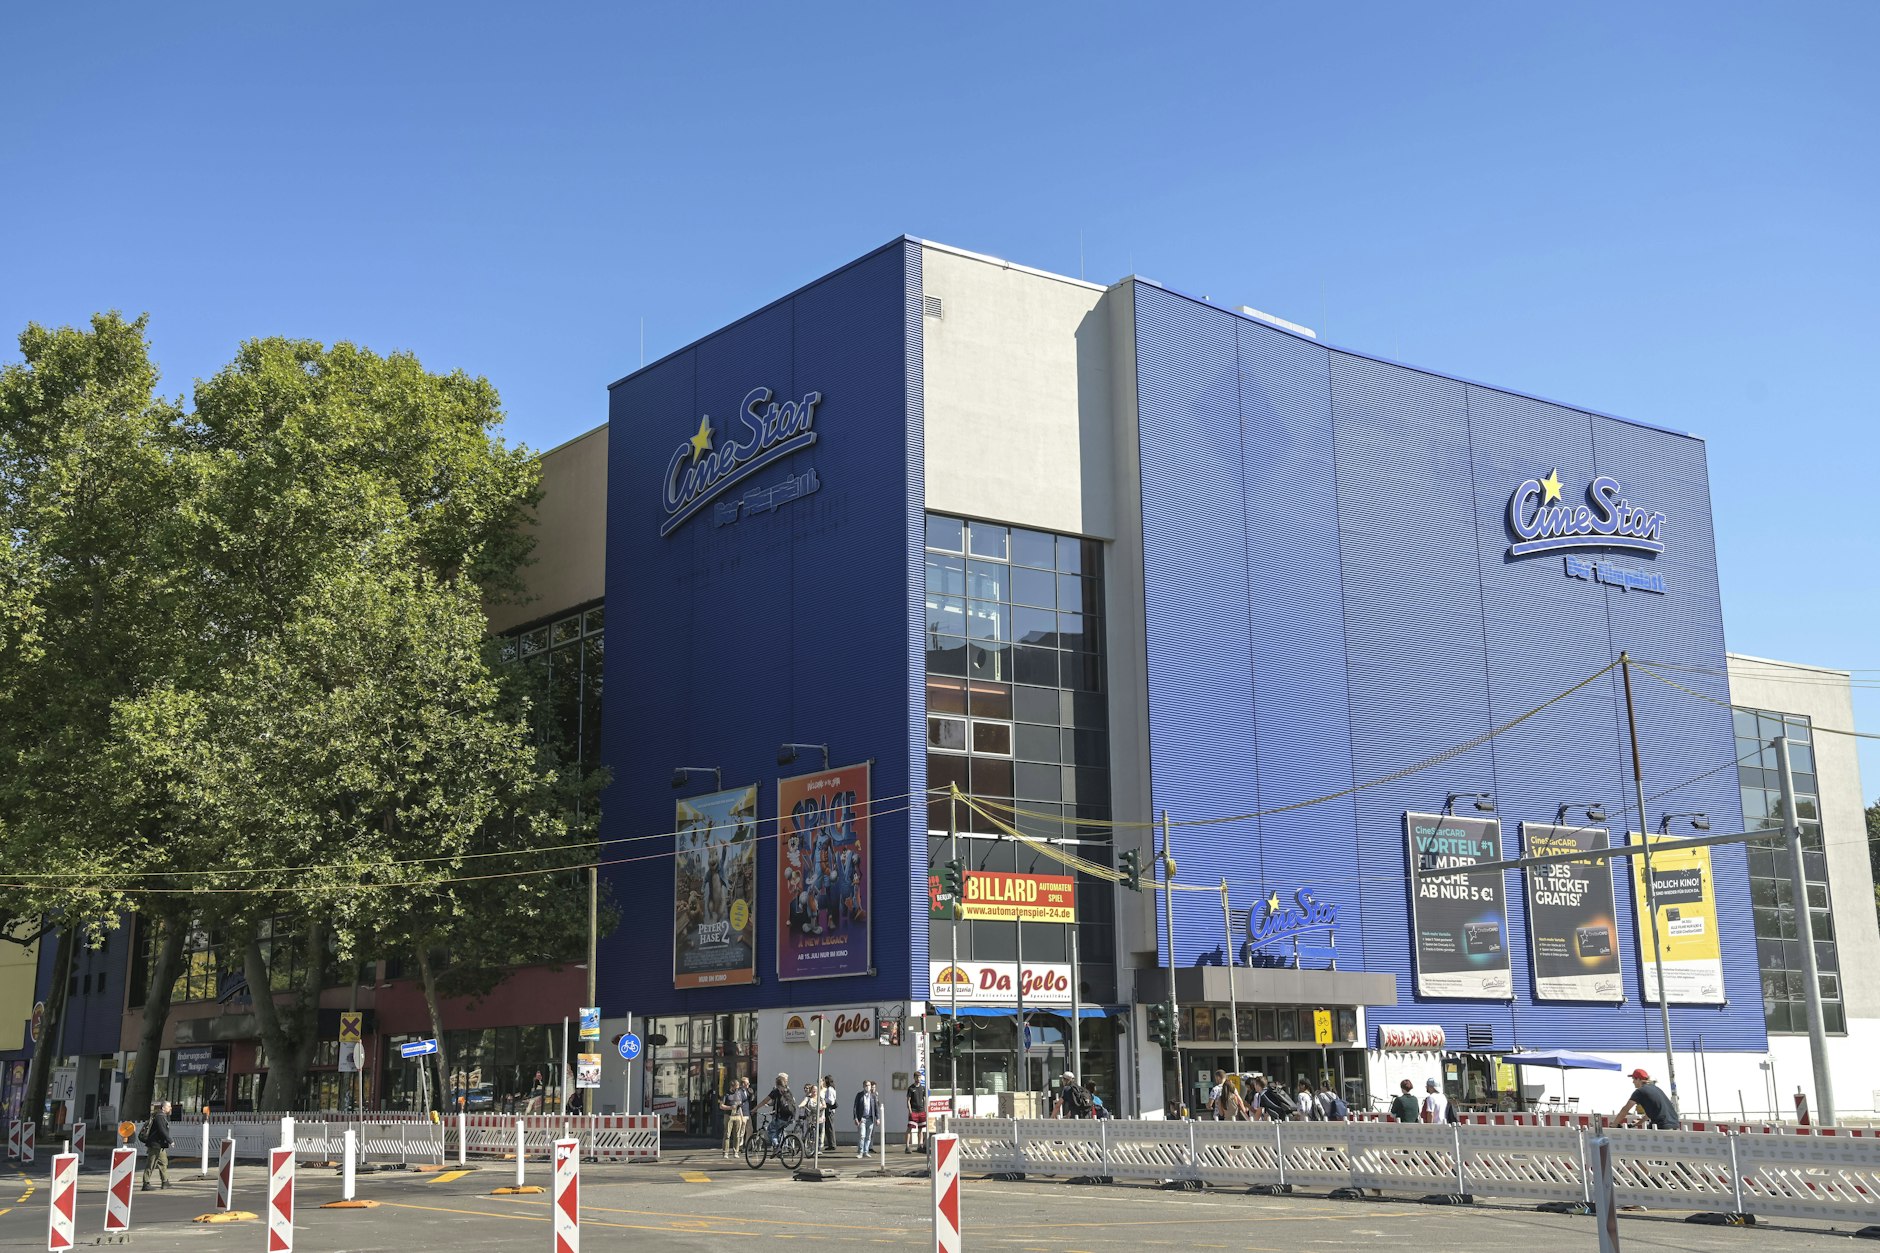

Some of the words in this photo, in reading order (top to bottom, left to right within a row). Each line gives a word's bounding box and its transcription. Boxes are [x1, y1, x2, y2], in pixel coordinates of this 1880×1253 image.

[662, 386, 822, 514] CineStar
[1512, 467, 1667, 541] CineStar
[792, 790, 857, 850] SPACE
[1416, 836, 1481, 856] VORTEIL
[1418, 853, 1447, 871] FILM
[1534, 864, 1571, 878] JEDES
[968, 877, 1038, 902] BILLARD
[1039, 882, 1072, 892] AUTOMATEN
[1534, 877, 1547, 891] 11.
[1548, 878, 1590, 893] TICKET
[1652, 879, 1679, 889] NDLICH
[1679, 878, 1700, 887] KINO!
[1048, 893, 1064, 903] SPIEL
[1420, 884, 1439, 899] AB
[1440, 885, 1469, 900] NUR
[1471, 886, 1479, 900] 5
[966, 906, 1071, 919] www.automatenspiel-24.de
[1250, 886, 1342, 941] CineStar
[698, 921, 722, 934] PETER
[721, 920, 730, 945] 2
[700, 933, 721, 944] HASE
[805, 938, 819, 947] NEW
[821, 934, 849, 946] LEGACY
[715, 974, 727, 982] KINO
[979, 967, 1011, 991] Da
[1021, 969, 1068, 996] Gelo
[936, 985, 946, 993] Bar
[834, 1013, 870, 1038] Gelo
